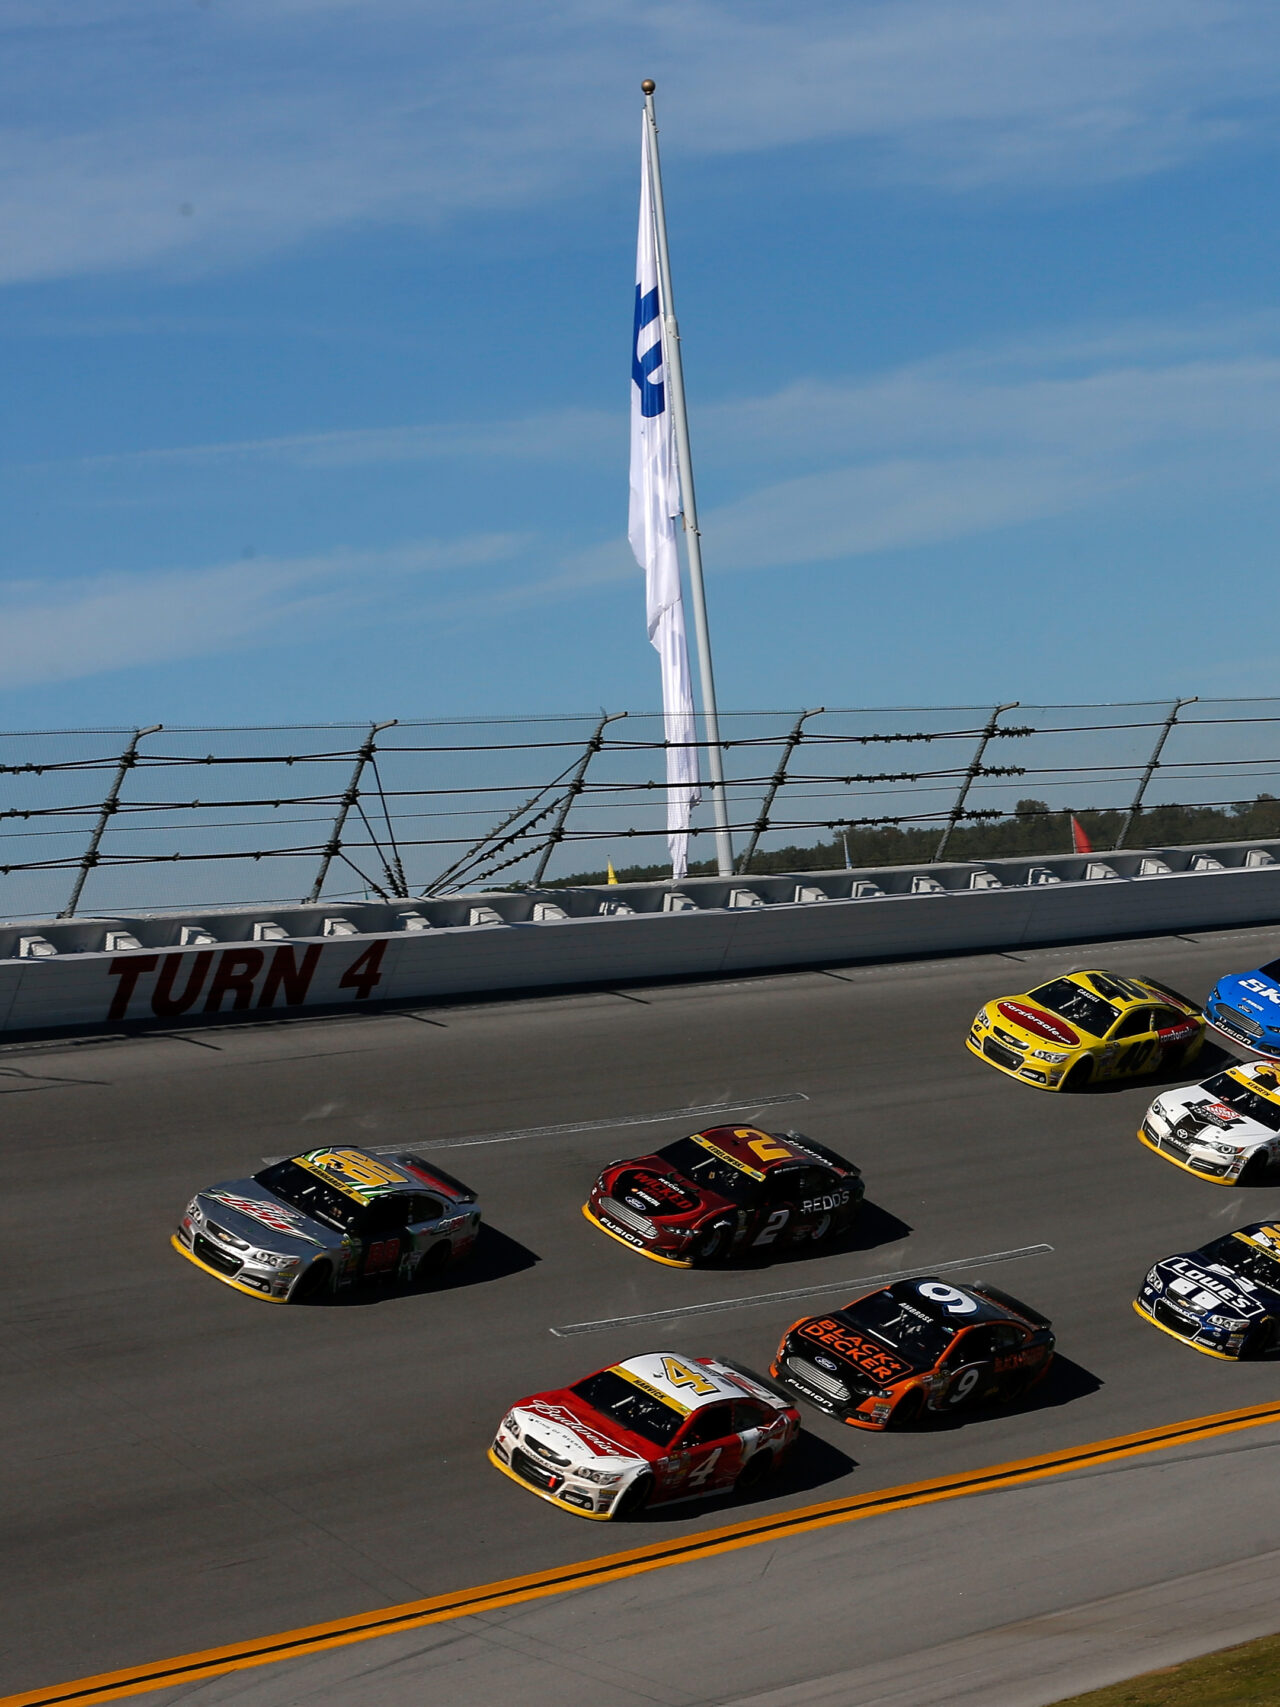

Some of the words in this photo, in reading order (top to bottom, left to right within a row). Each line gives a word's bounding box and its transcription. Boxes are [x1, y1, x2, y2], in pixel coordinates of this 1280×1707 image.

[107, 943, 324, 1020] TURN
[338, 939, 389, 1000] 4
[1215, 1021, 1252, 1045] FUSION
[733, 1129, 794, 1162] 2
[631, 1171, 694, 1211] WICKED
[599, 1216, 645, 1248] FUSION
[752, 1210, 789, 1246] 2
[917, 1281, 978, 1314] 9
[1172, 1260, 1252, 1309] LOWE'S
[898, 1301, 935, 1324] AMBROSE
[803, 1325, 894, 1381] DECKER
[817, 1318, 903, 1371] BLACK+
[633, 1378, 667, 1401] HARVICK
[659, 1355, 720, 1397] 4
[787, 1377, 834, 1408] FUSION
[951, 1369, 979, 1403] 9
[531, 1398, 628, 1463] Budweise
[687, 1447, 723, 1488] 4
